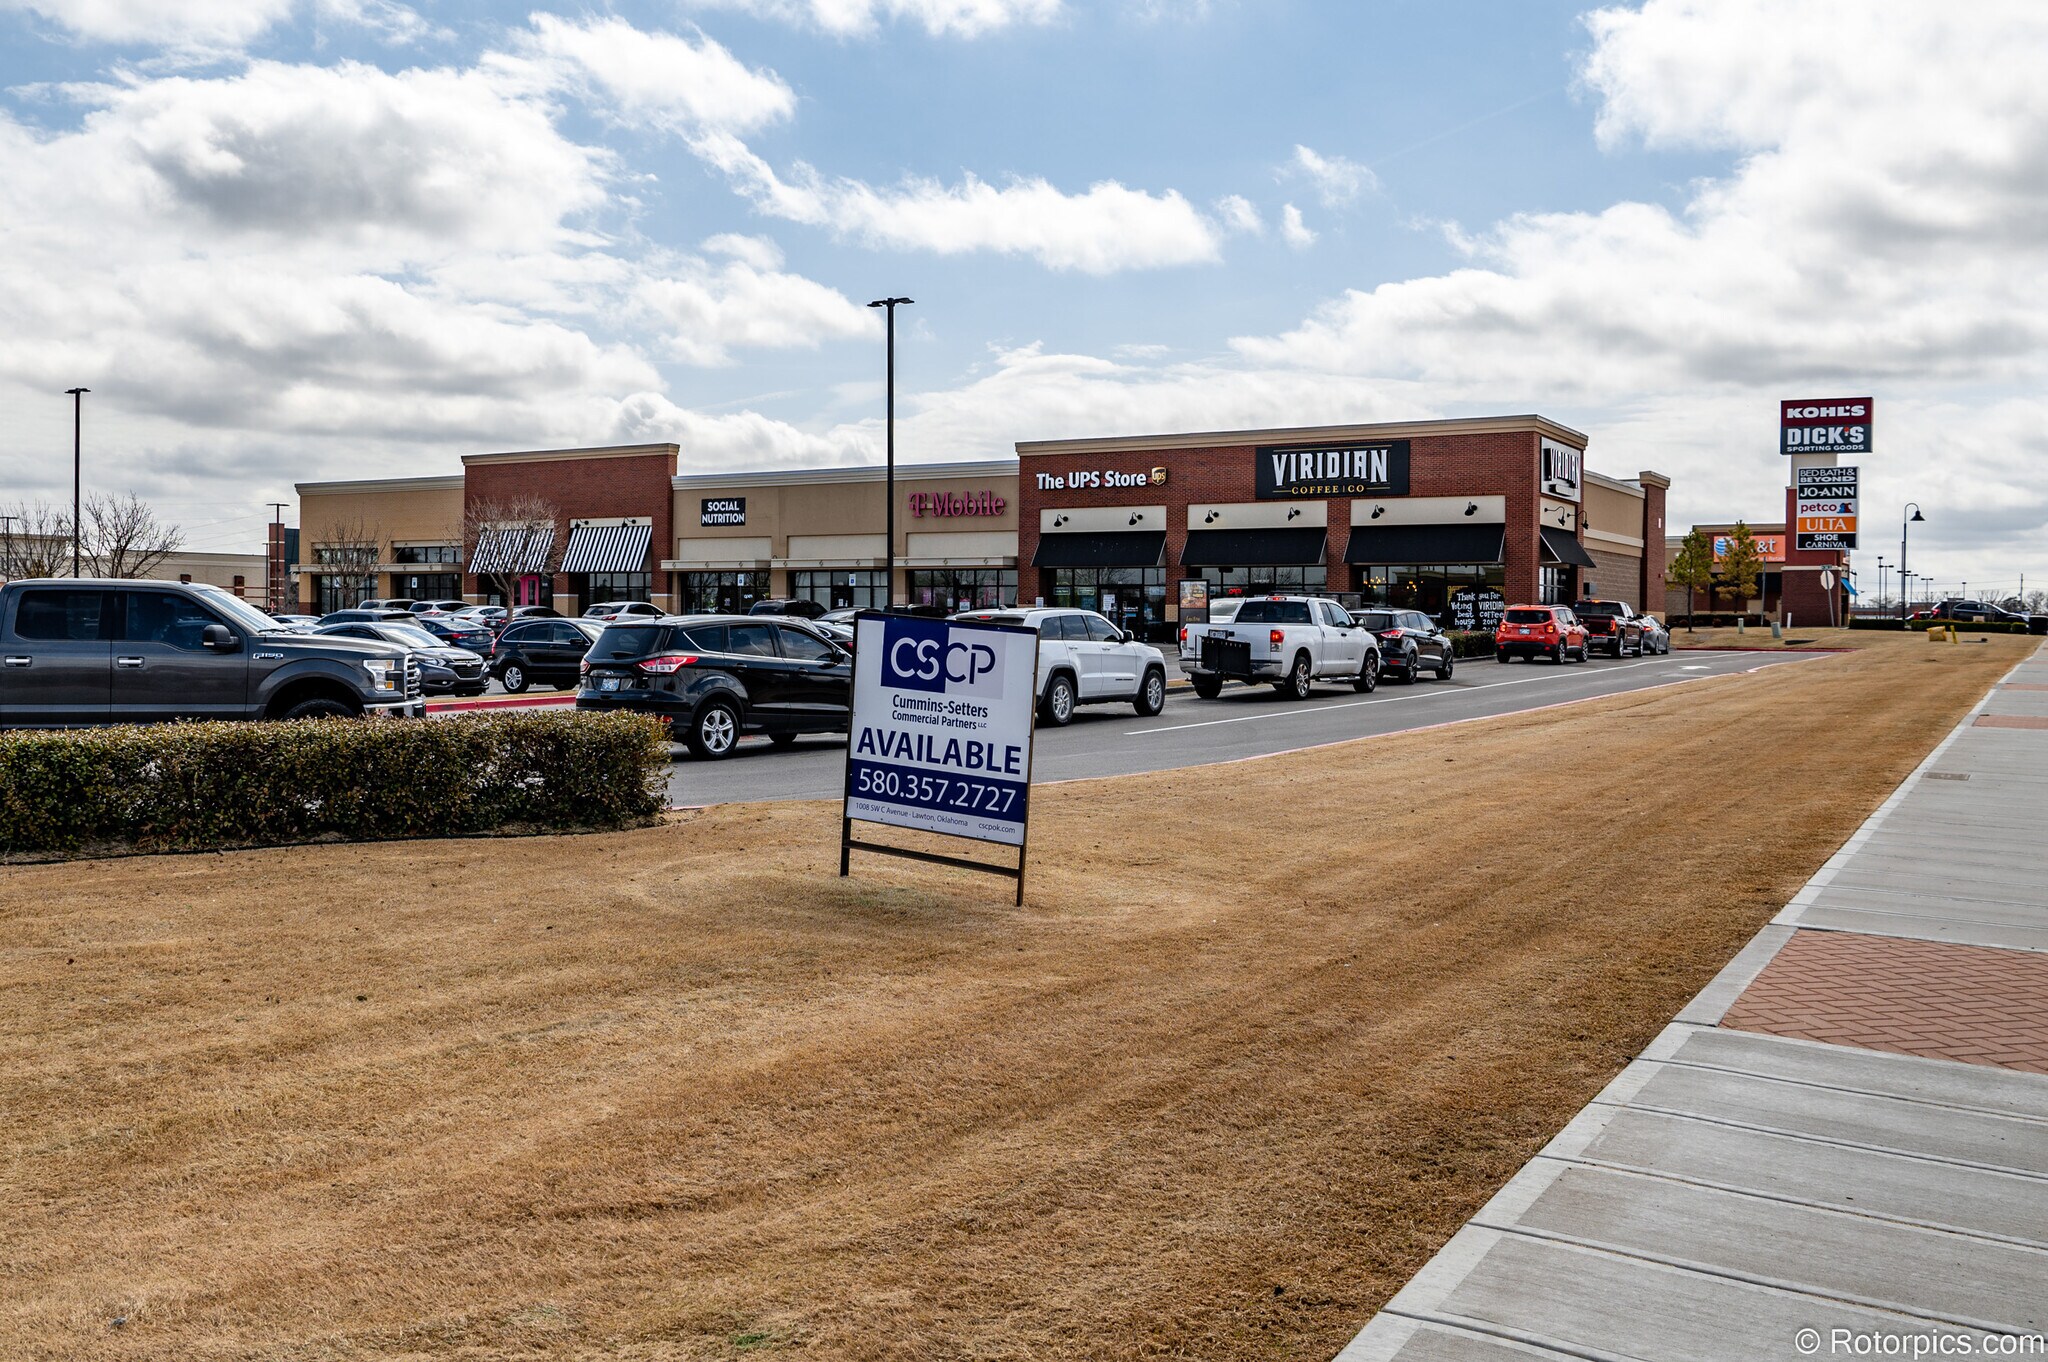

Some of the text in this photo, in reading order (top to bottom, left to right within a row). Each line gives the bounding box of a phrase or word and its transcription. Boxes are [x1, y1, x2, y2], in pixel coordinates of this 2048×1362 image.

[1786, 405, 1865, 419] KOHL'S
[1787, 426, 1864, 445] DICK'S
[1272, 449, 1388, 486] VIRIDIAN
[1820, 469, 1846, 477] BATH
[1847, 468, 1855, 476] &
[1036, 473, 1065, 490] The
[1068, 471, 1100, 488] UPS
[1104, 470, 1147, 487] Store
[1291, 484, 1365, 495] COFFEE CO
[1800, 487, 1855, 497] JO-ANN
[707, 501, 740, 512] SOCIAL
[909, 490, 1005, 518] T-Mobile
[1801, 503, 1837, 514] petco
[701, 513, 745, 524] NUTRITION
[1806, 518, 1847, 531] ULTA
[1456, 592, 1476, 601] Thank
[890, 637, 996, 685] CSCP
[892, 694, 989, 719] Cummins-Setters
[891, 710, 940, 726] Commercial
[941, 715, 977, 730] Partners
[856, 727, 1022, 775] AVAILABLE
[858, 767, 1017, 813] 580.357.2727
[855, 802, 870, 811] 1008
[870, 804, 881, 812] SW
[886, 807, 909, 818] Avenue
[912, 812, 936, 822] Lawton,
[936, 815, 969, 827] Oklahoma
[978, 822, 1017, 835] cscpok.com
